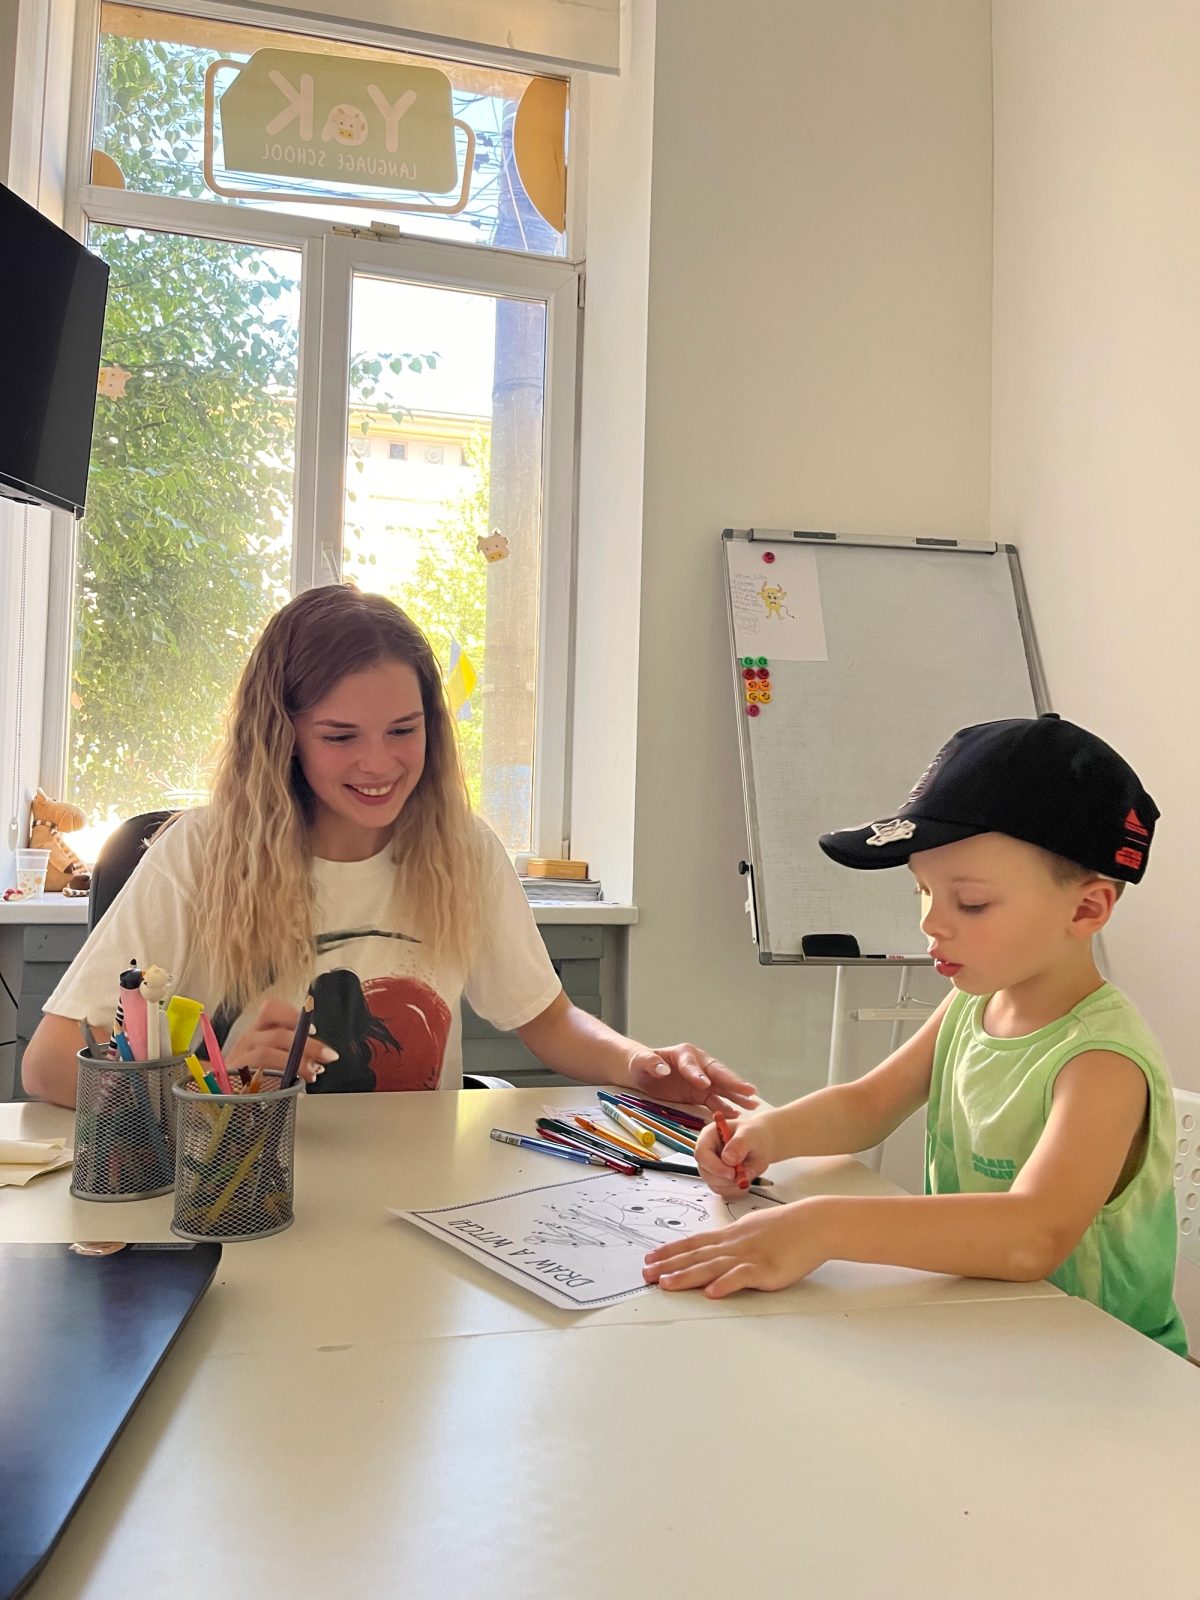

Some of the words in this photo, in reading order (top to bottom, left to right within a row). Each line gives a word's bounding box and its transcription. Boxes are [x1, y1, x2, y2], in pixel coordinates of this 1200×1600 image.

[448, 1218, 513, 1248] WITCH!
[508, 1248, 536, 1256] A
[524, 1259, 595, 1288] DRAW
